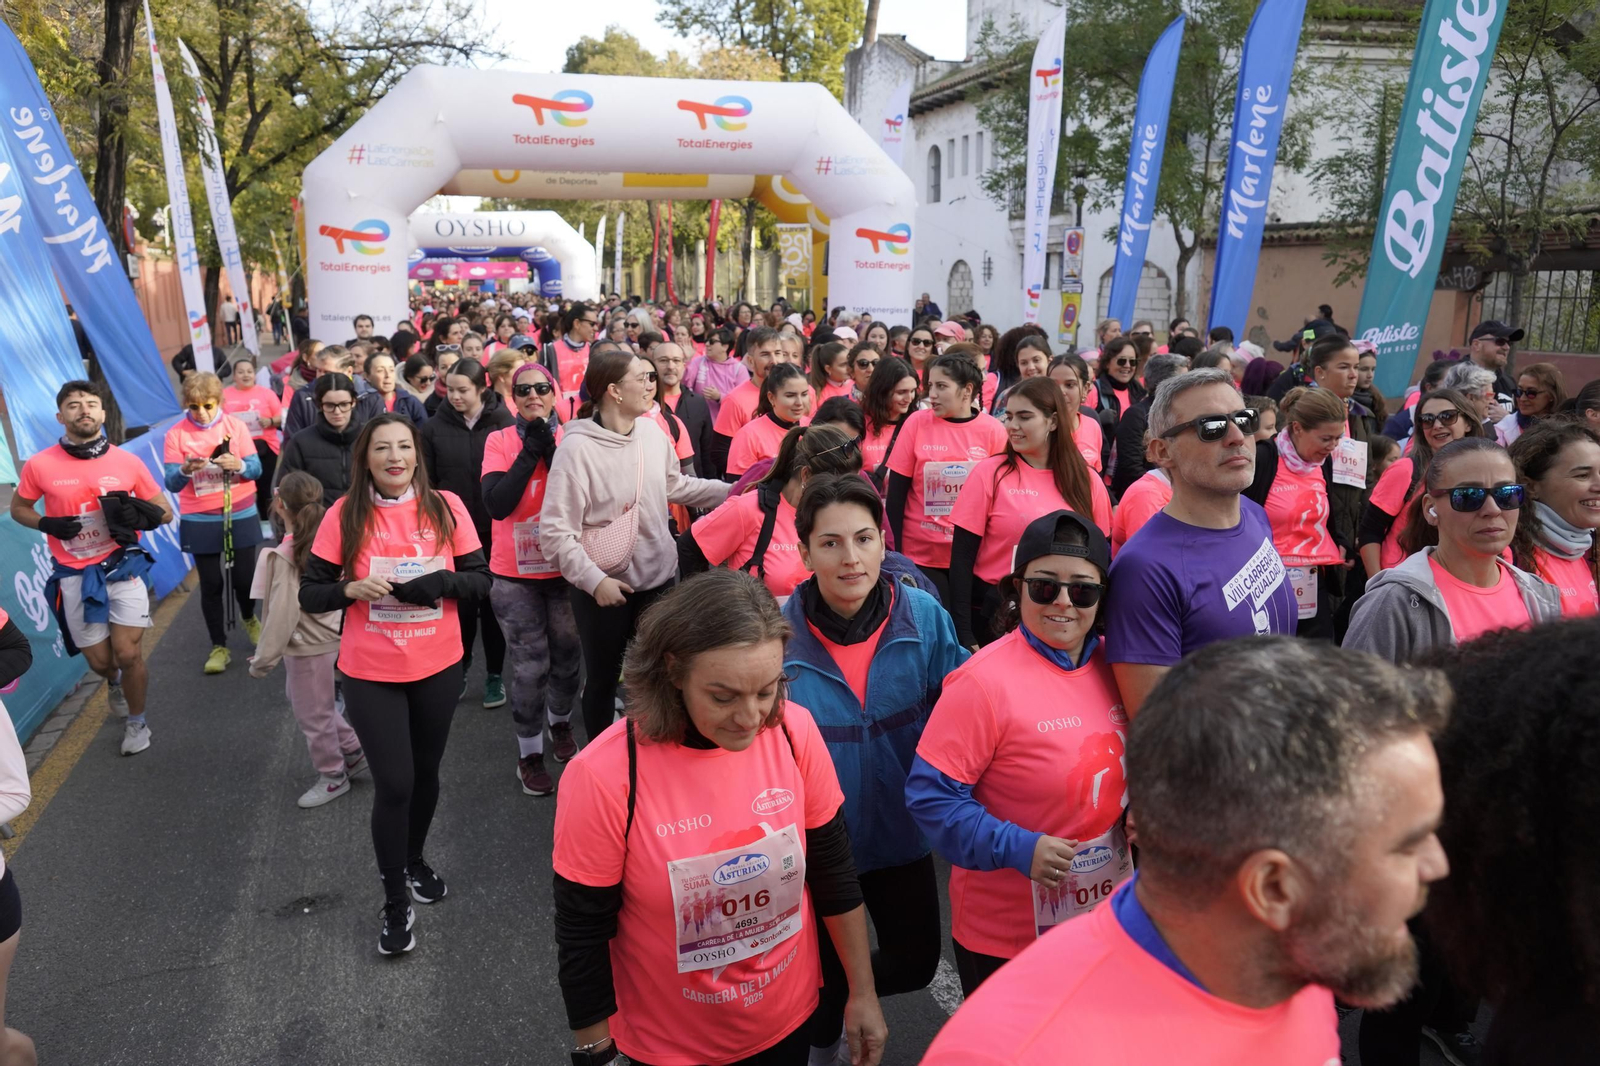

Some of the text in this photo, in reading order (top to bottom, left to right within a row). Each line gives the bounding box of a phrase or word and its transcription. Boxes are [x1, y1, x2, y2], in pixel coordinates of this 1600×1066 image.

[512, 134, 595, 148] TotalEnergies
[677, 138, 753, 151] TotalEnergies
[1384, 0, 1498, 278] Batiste
[1227, 84, 1279, 240] Marlene
[559, 177, 598, 186] Deportes
[435, 219, 525, 237] OYSHO
[319, 262, 391, 274] TotalEnergies
[1361, 322, 1420, 345] Batiste
[1395, 343, 1418, 353] SECO
[1341, 456, 1358, 467] 016
[53, 478, 79, 486] OYSHO
[1272, 484, 1299, 493] OYSHO
[1009, 488, 1039, 497] OYSHO
[78, 529, 100, 541] 016
[1227, 553, 1274, 604] VIII CARRERA
[1228, 573, 1244, 589] DOS
[1251, 563, 1281, 602] IGUALDAD
[378, 611, 402, 619] OYSHO
[393, 630, 403, 638] DE
[404, 630, 413, 638] LA
[414, 626, 436, 637] MUJER
[1037, 715, 1082, 733] OYSHO
[756, 795, 792, 812] ASTURIANA
[656, 814, 712, 837] OYSHO
[1071, 853, 1111, 870] ASTURIANA
[718, 860, 767, 882] ASTURIANA
[683, 879, 711, 891] SUMA
[1075, 878, 1113, 905] 016
[722, 889, 771, 917] 016
[735, 916, 759, 929] 4693
[697, 937, 726, 948] CARRERA
[726, 934, 734, 942] DE
[745, 925, 765, 937] MUJER
[693, 946, 736, 964] OYSHO
[682, 946, 798, 1005] CARRERA DE LA MUJER
[744, 991, 764, 1008] 2025
